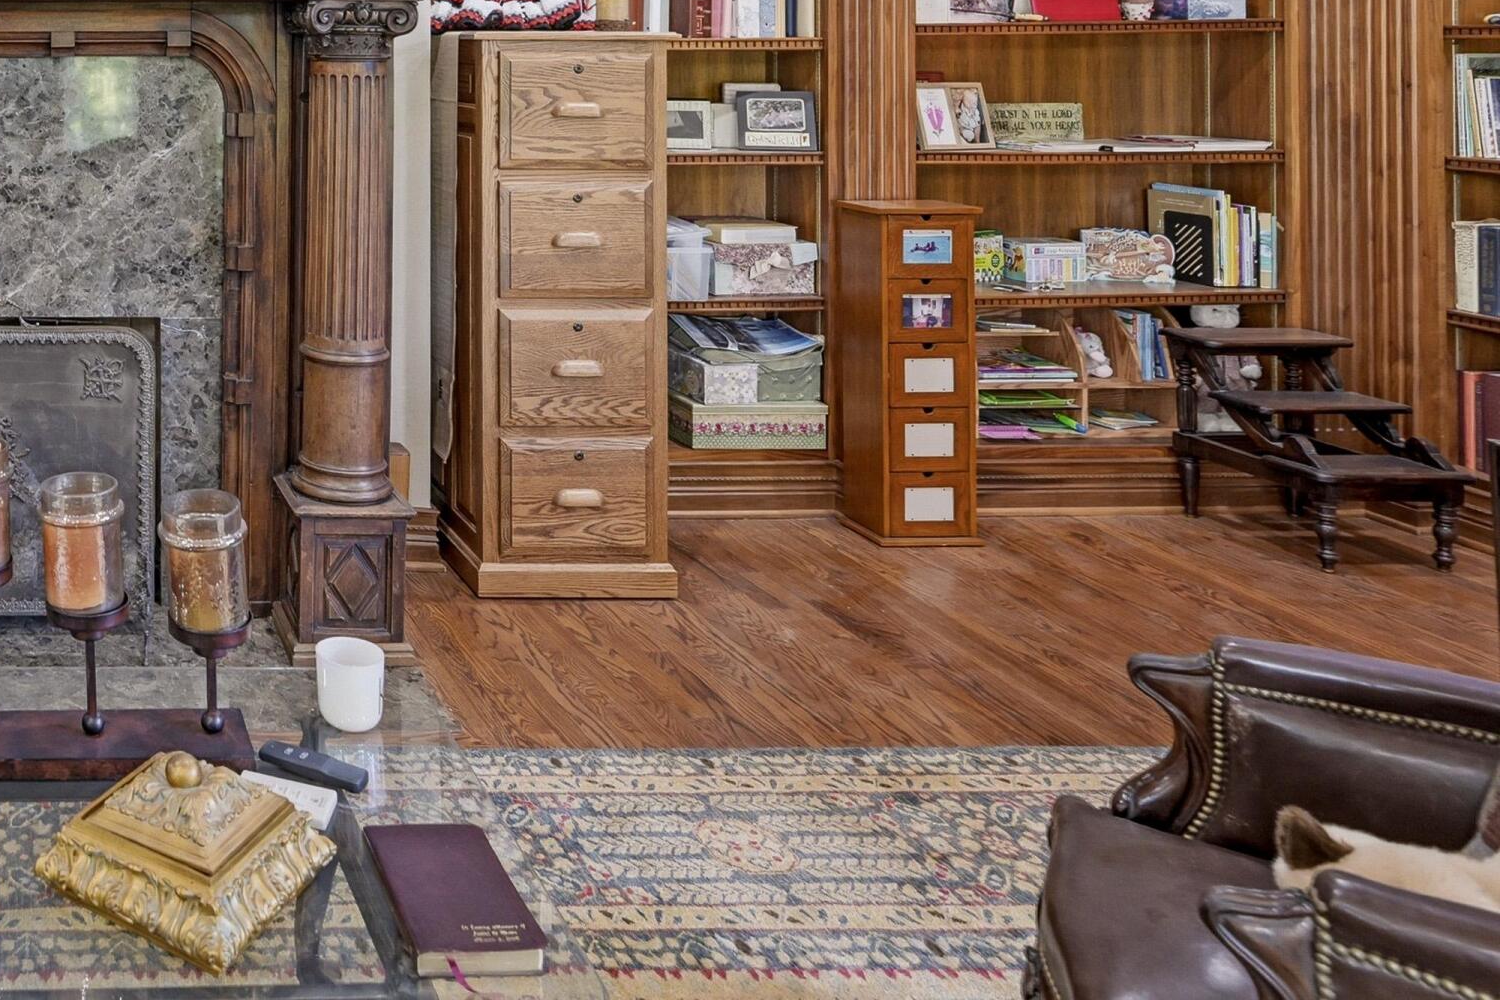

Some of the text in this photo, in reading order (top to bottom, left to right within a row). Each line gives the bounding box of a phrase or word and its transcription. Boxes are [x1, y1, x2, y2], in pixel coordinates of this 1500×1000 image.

[1034, 109, 1048, 119] THE
[1052, 109, 1073, 119] LORD
[1030, 121, 1052, 131] YOUR
